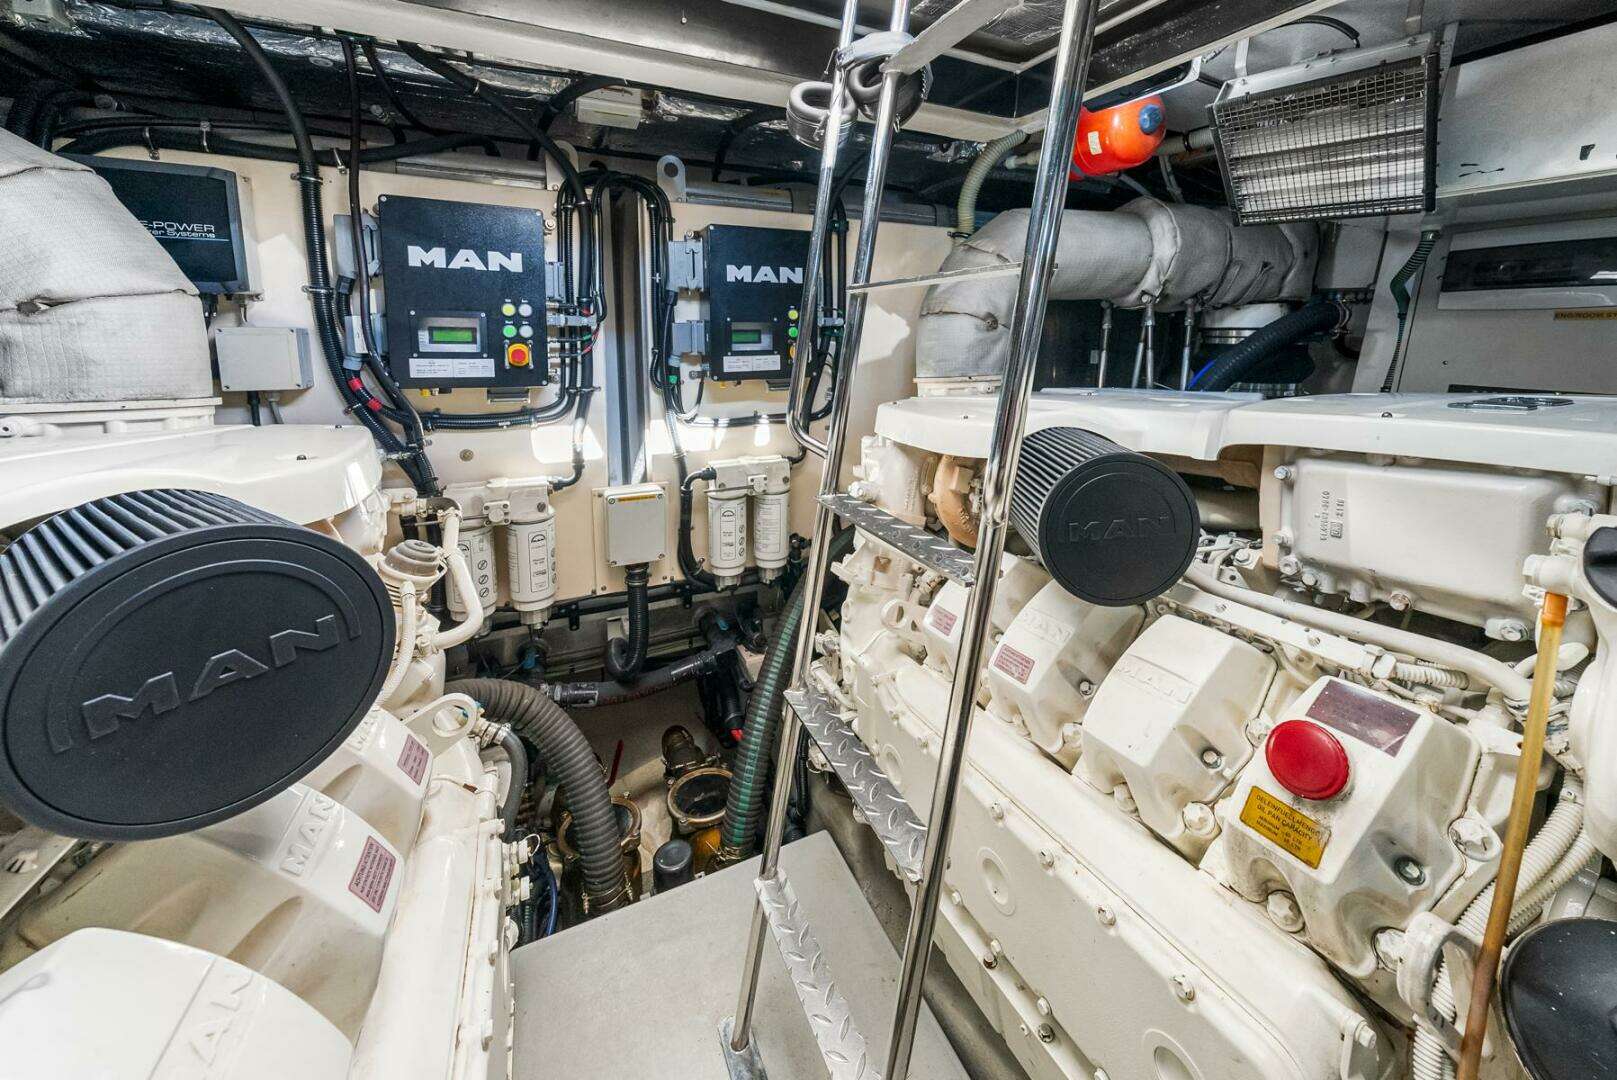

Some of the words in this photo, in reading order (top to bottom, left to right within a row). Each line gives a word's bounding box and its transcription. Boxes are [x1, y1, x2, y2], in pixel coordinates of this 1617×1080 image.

[167, 230, 216, 239] Systems
[407, 245, 523, 273] MAN
[726, 264, 803, 284] MAN
[1068, 516, 1169, 545] MAN
[82, 614, 339, 740] MAN
[280, 795, 336, 877] MAN
[1268, 810, 1281, 822] PAN
[1282, 819, 1313, 841] CAPACITY
